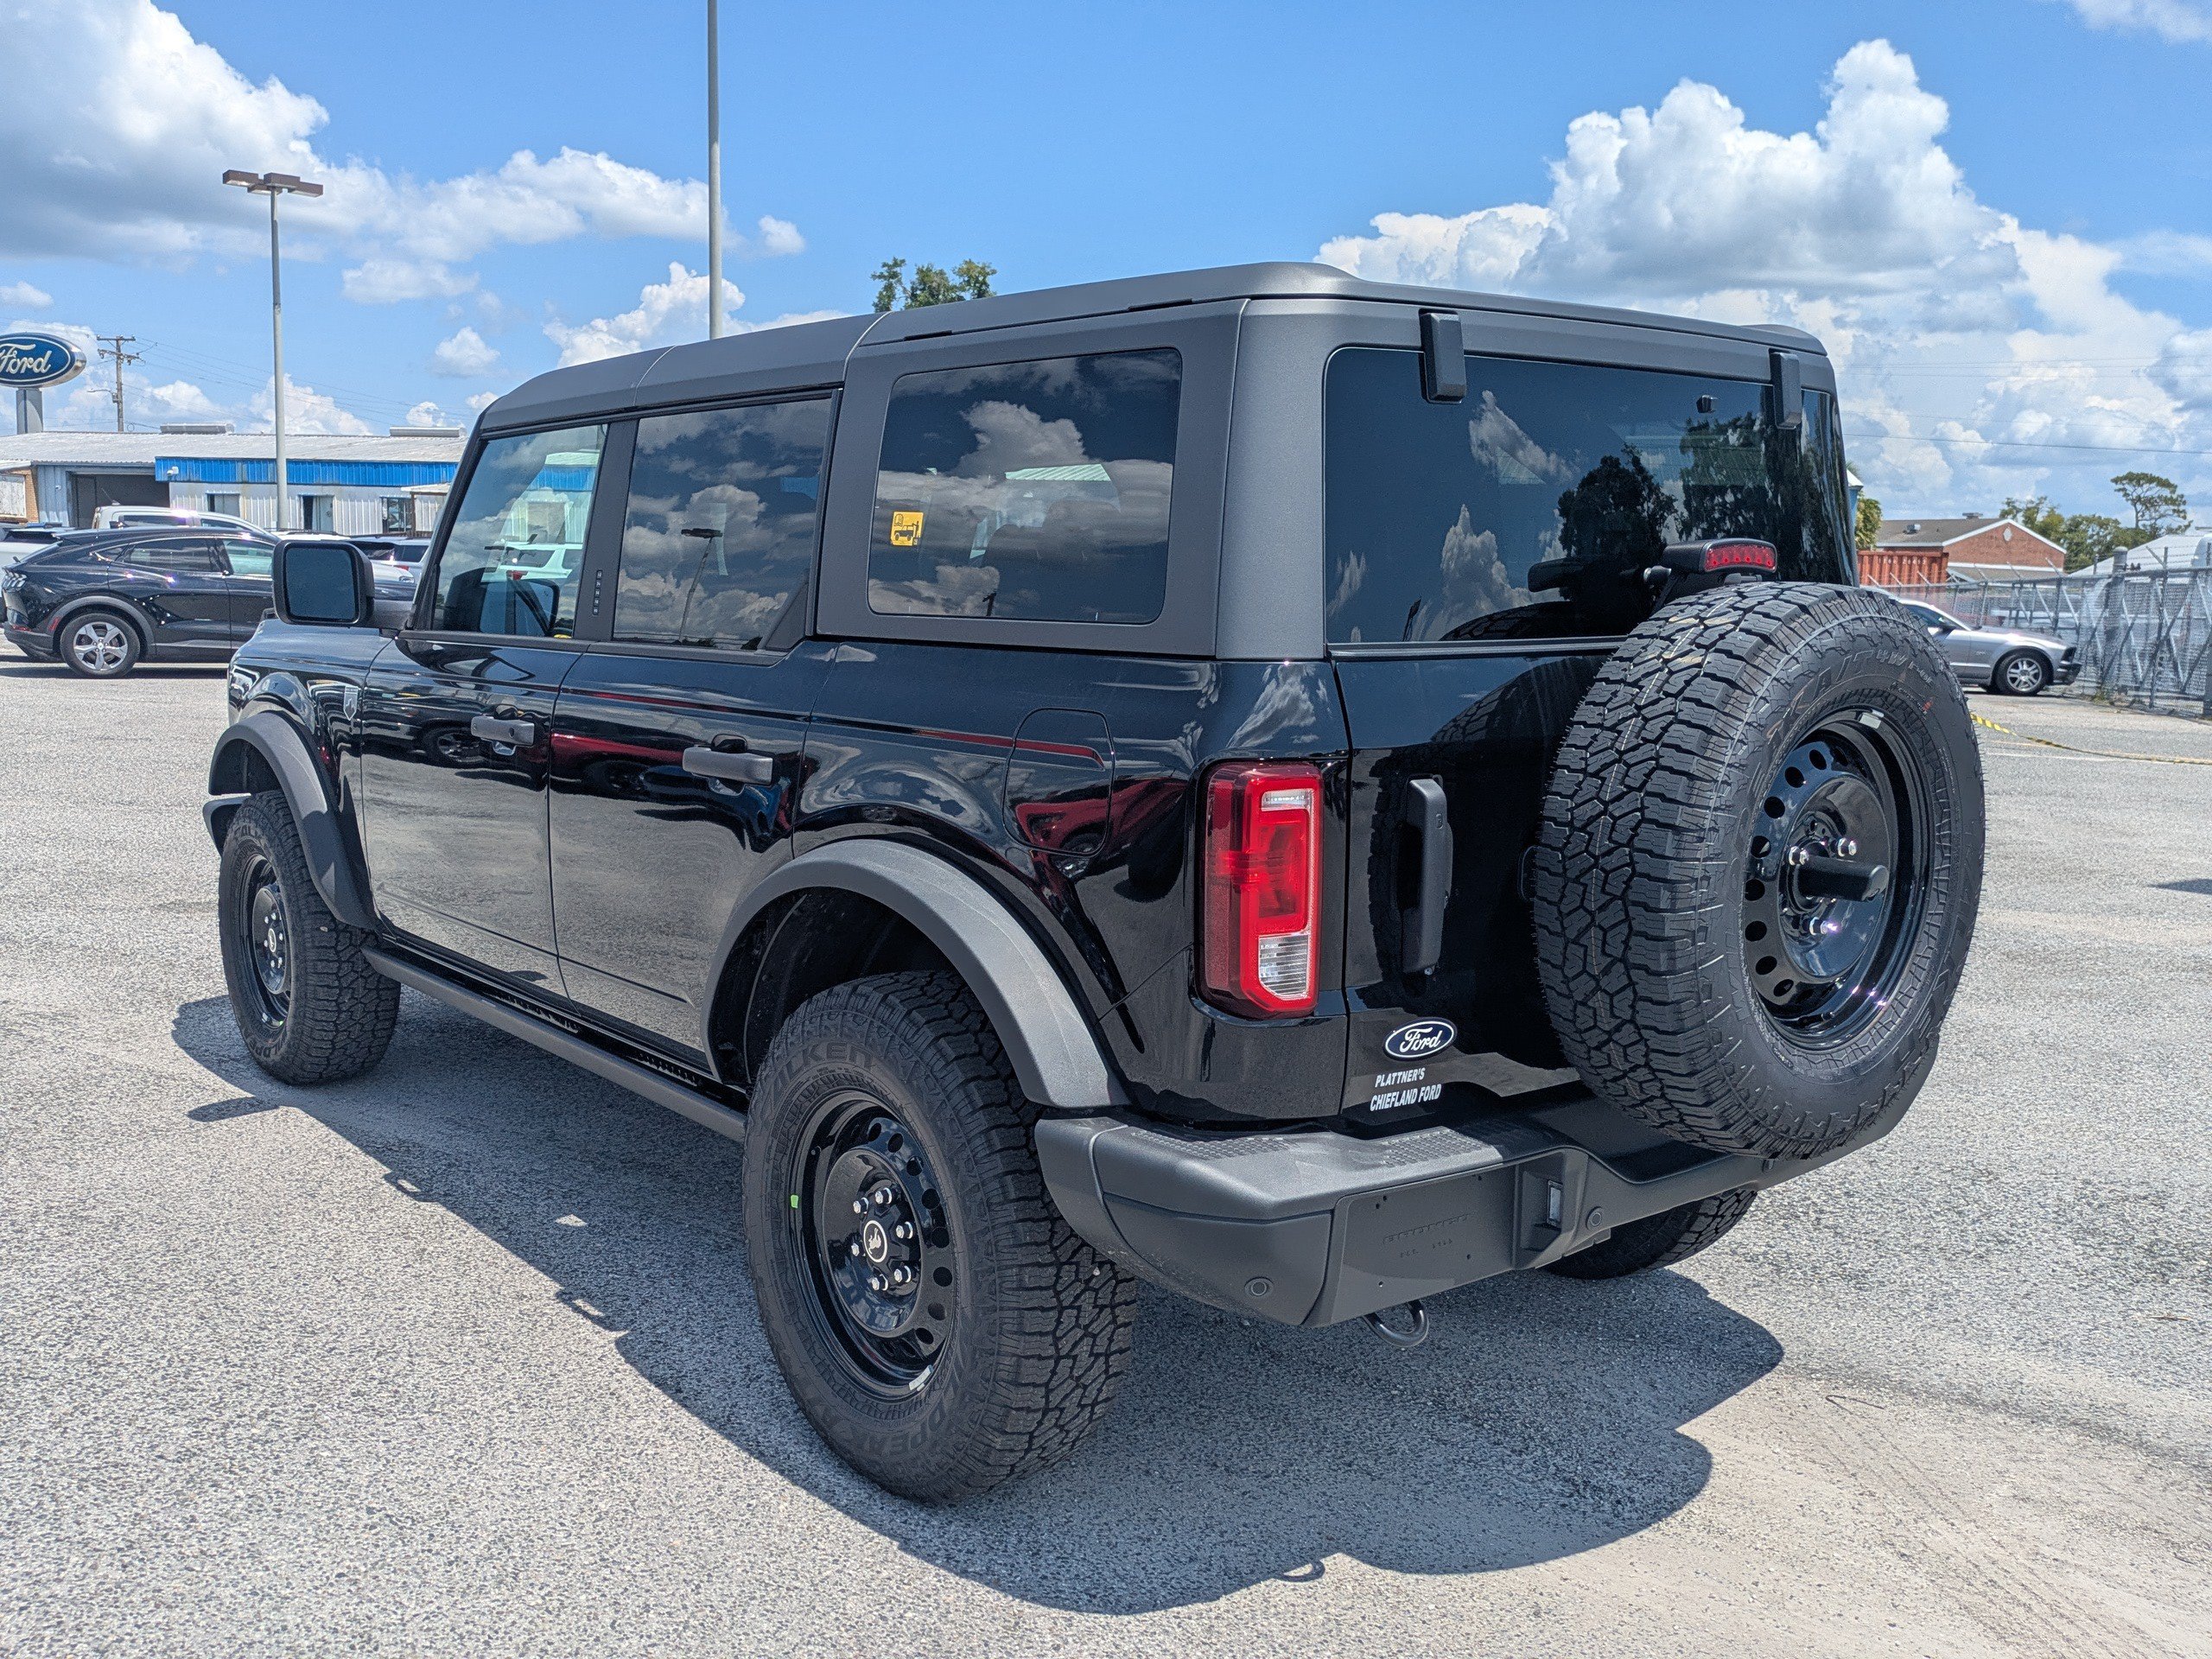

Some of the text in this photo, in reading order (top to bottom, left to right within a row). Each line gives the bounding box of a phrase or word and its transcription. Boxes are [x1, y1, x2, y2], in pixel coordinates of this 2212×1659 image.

[0, 343, 52, 374] Ford
[1399, 1027, 1443, 1052] Ford
[1374, 1067, 1427, 1088] PLATTNER'S
[1370, 1084, 1442, 1111] CHIEFLAND FORD
